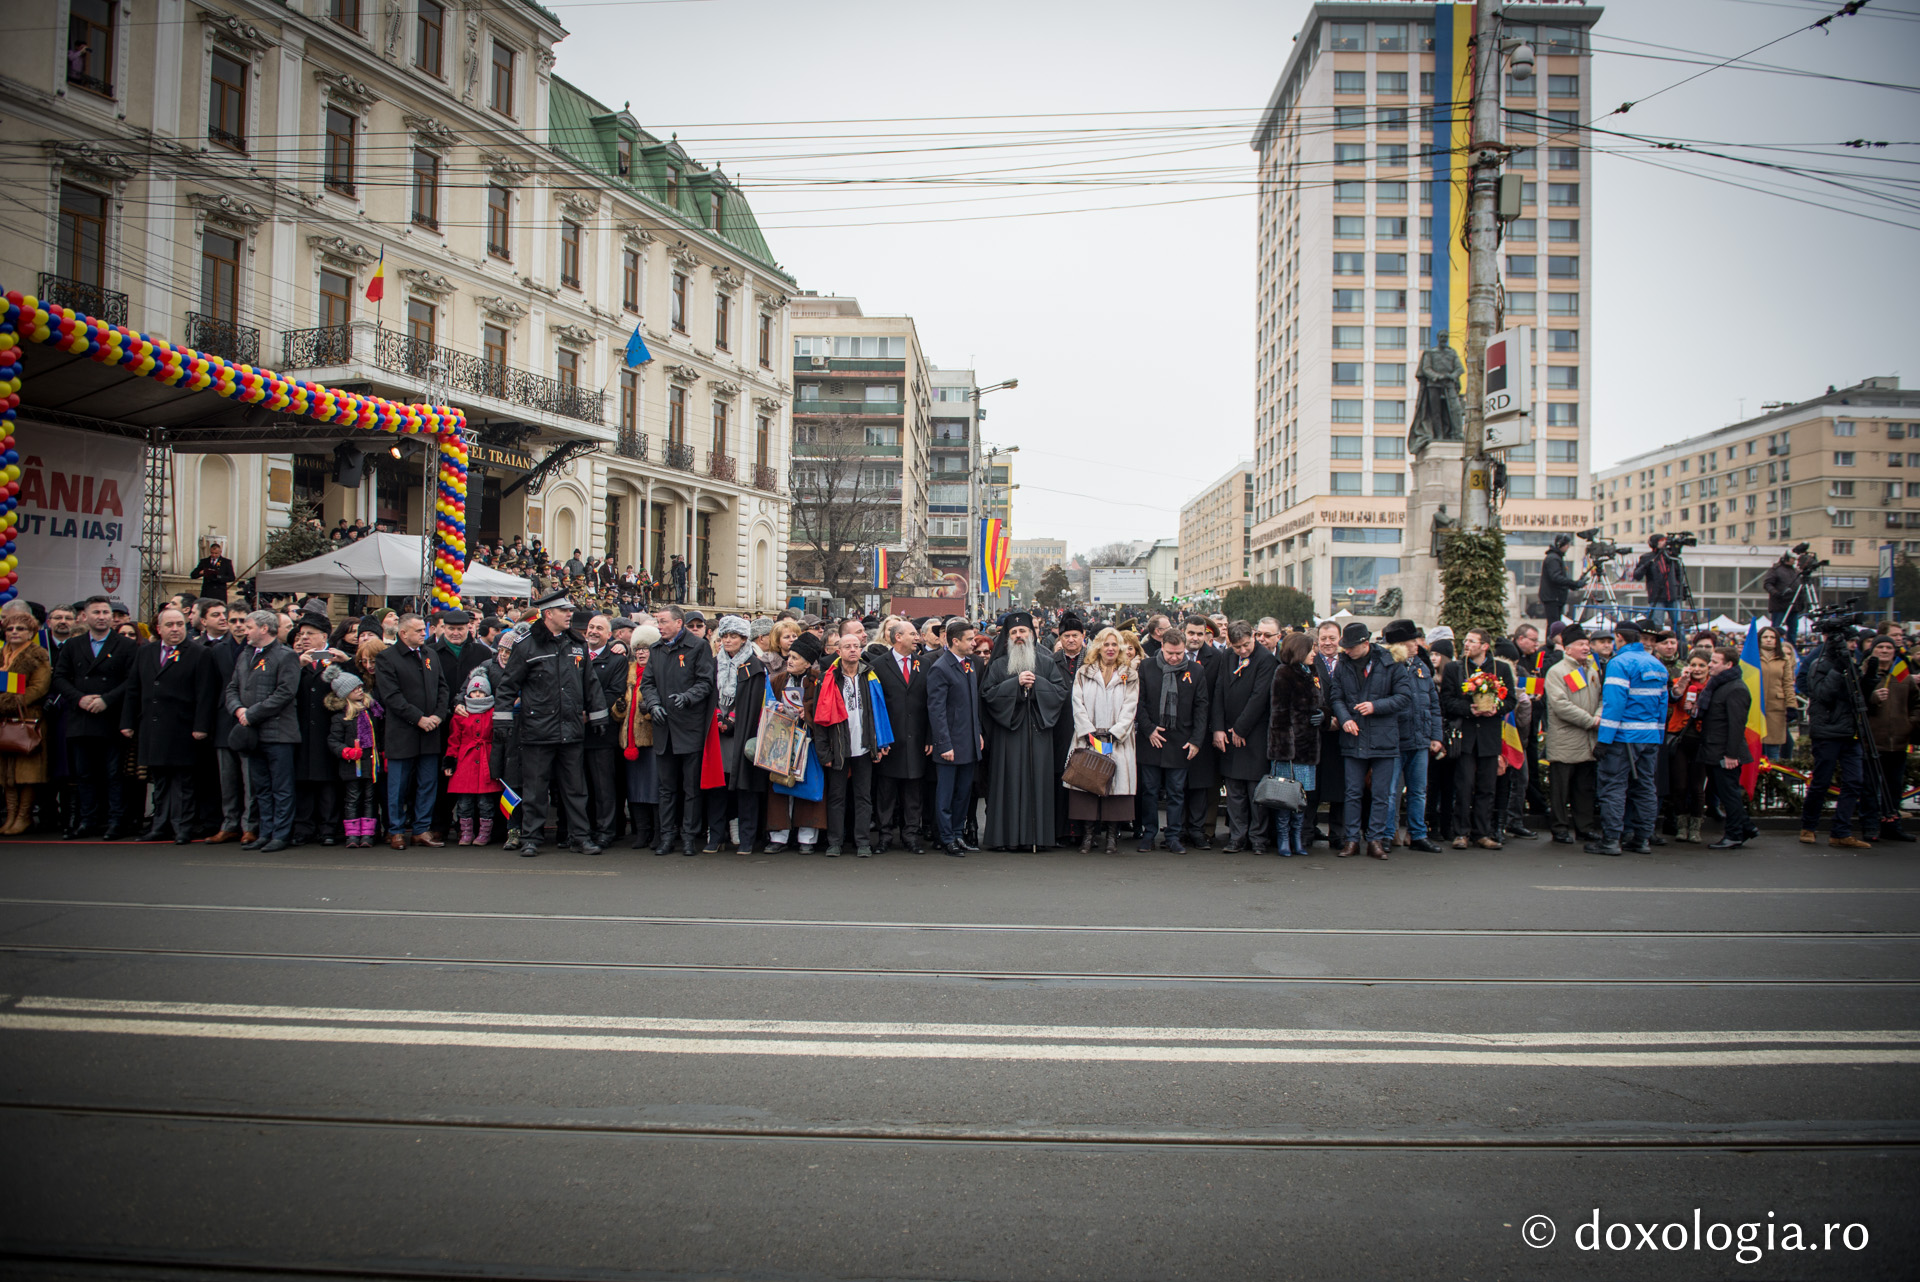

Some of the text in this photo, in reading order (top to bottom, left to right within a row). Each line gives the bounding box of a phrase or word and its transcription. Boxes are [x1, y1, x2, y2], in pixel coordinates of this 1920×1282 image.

[488, 449, 531, 470] TRAIAN
[17, 455, 124, 517] ÂNIA
[14, 513, 123, 547] UT LA IAȘI
